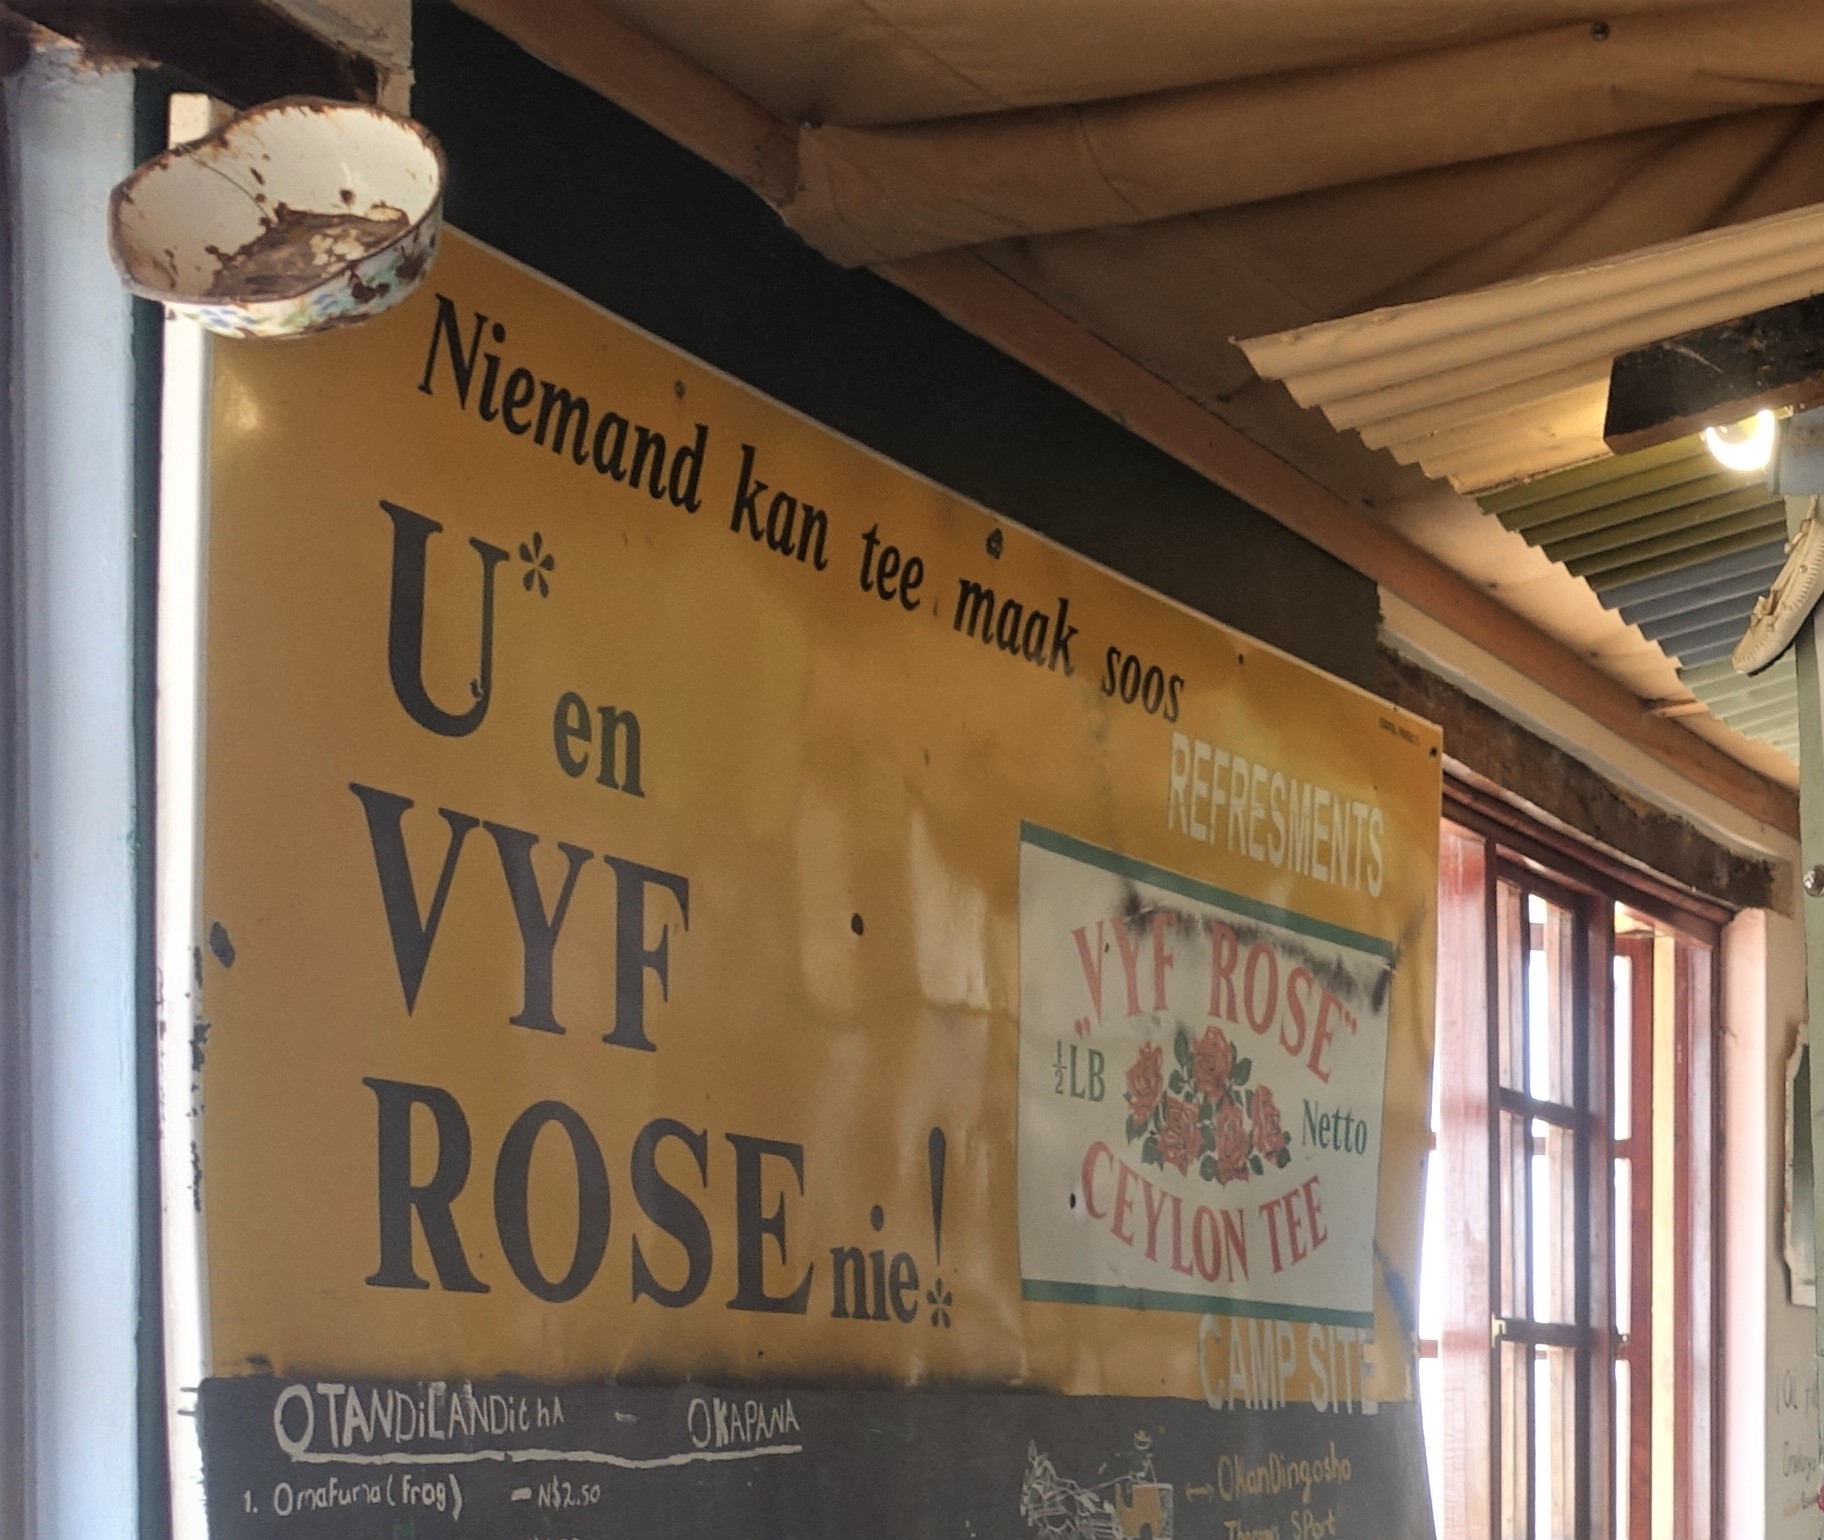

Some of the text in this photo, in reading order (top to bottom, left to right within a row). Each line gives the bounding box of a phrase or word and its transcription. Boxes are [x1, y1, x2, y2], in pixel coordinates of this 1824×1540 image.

[417, 293, 1186, 723] Niemand kan tee maak soos
[553, 690, 646, 798] en
[1168, 732, 1385, 898] REFRESMENTS
[349, 782, 691, 1052] VYF
[362, 1076, 814, 1317] ROSE
[1302, 1098, 1367, 1155] Netto
[1081, 1141, 1328, 1285] CEYLON TEE
[687, 1396, 800, 1448] OKAPANA
[1201, 1313, 1378, 1415] CAMP SITE
